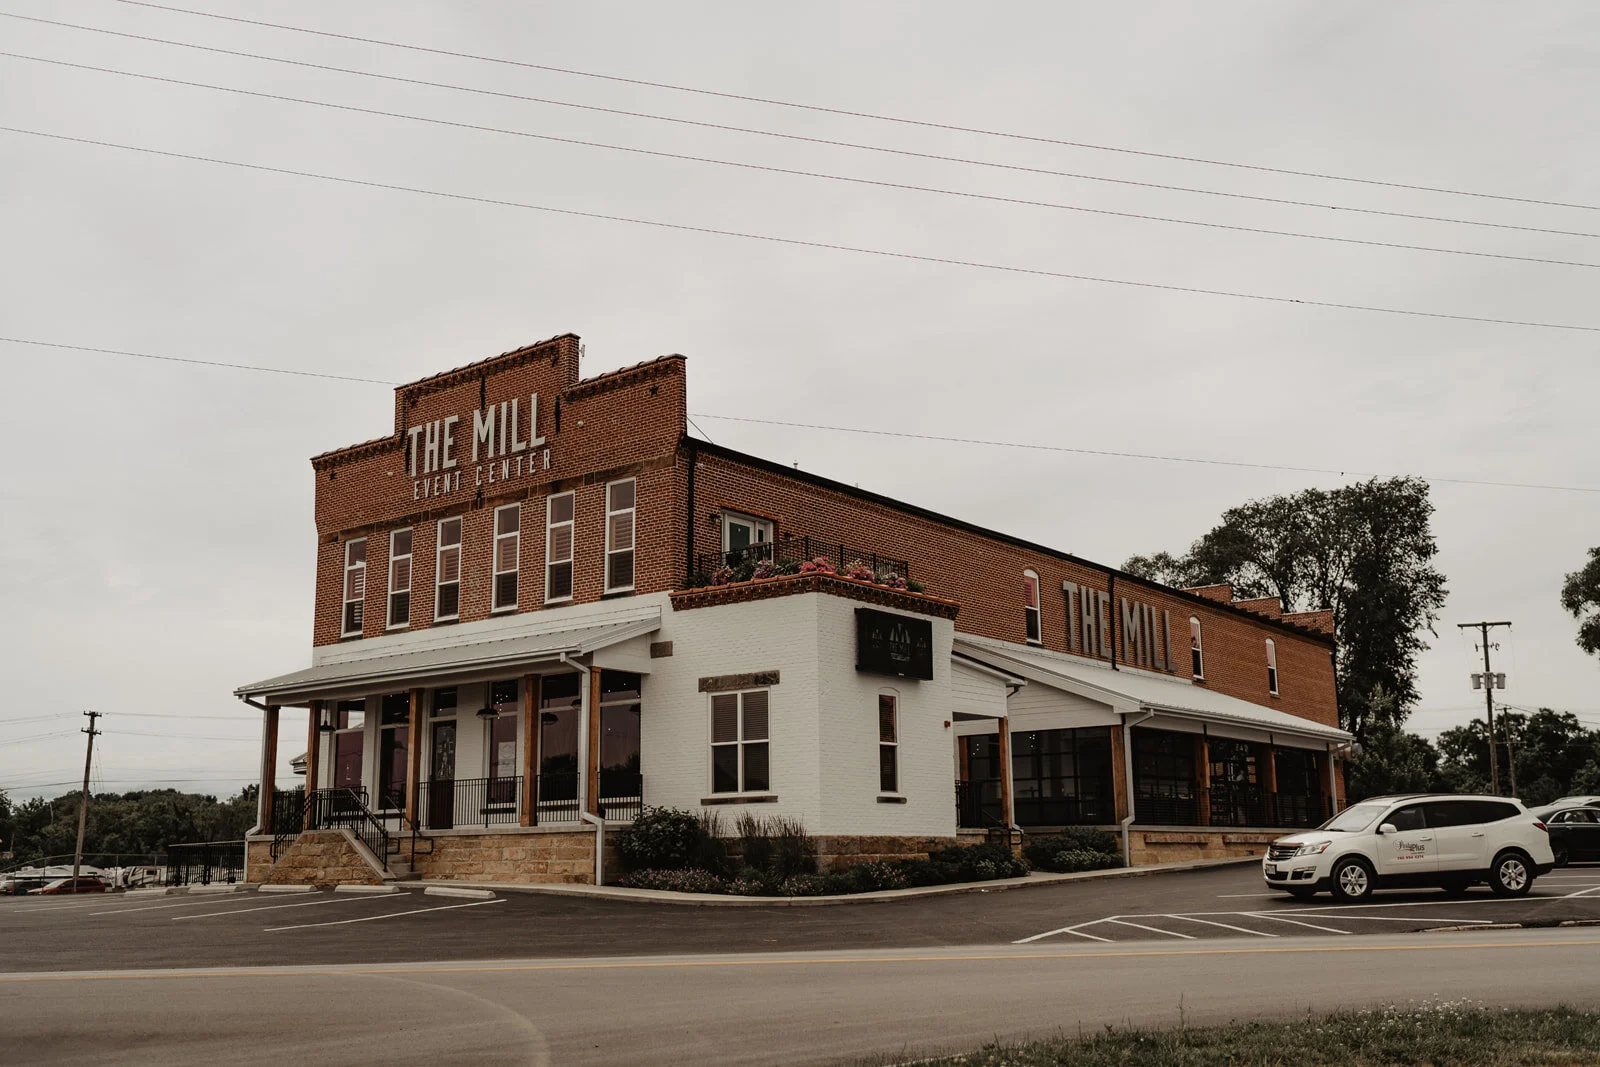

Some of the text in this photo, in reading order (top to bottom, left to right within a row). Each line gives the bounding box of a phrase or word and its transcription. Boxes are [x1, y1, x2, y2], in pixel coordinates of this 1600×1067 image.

[407, 392, 546, 478] THE MILL
[413, 448, 551, 501] EVENT CENTER
[1062, 580, 1179, 673] THE MILL
